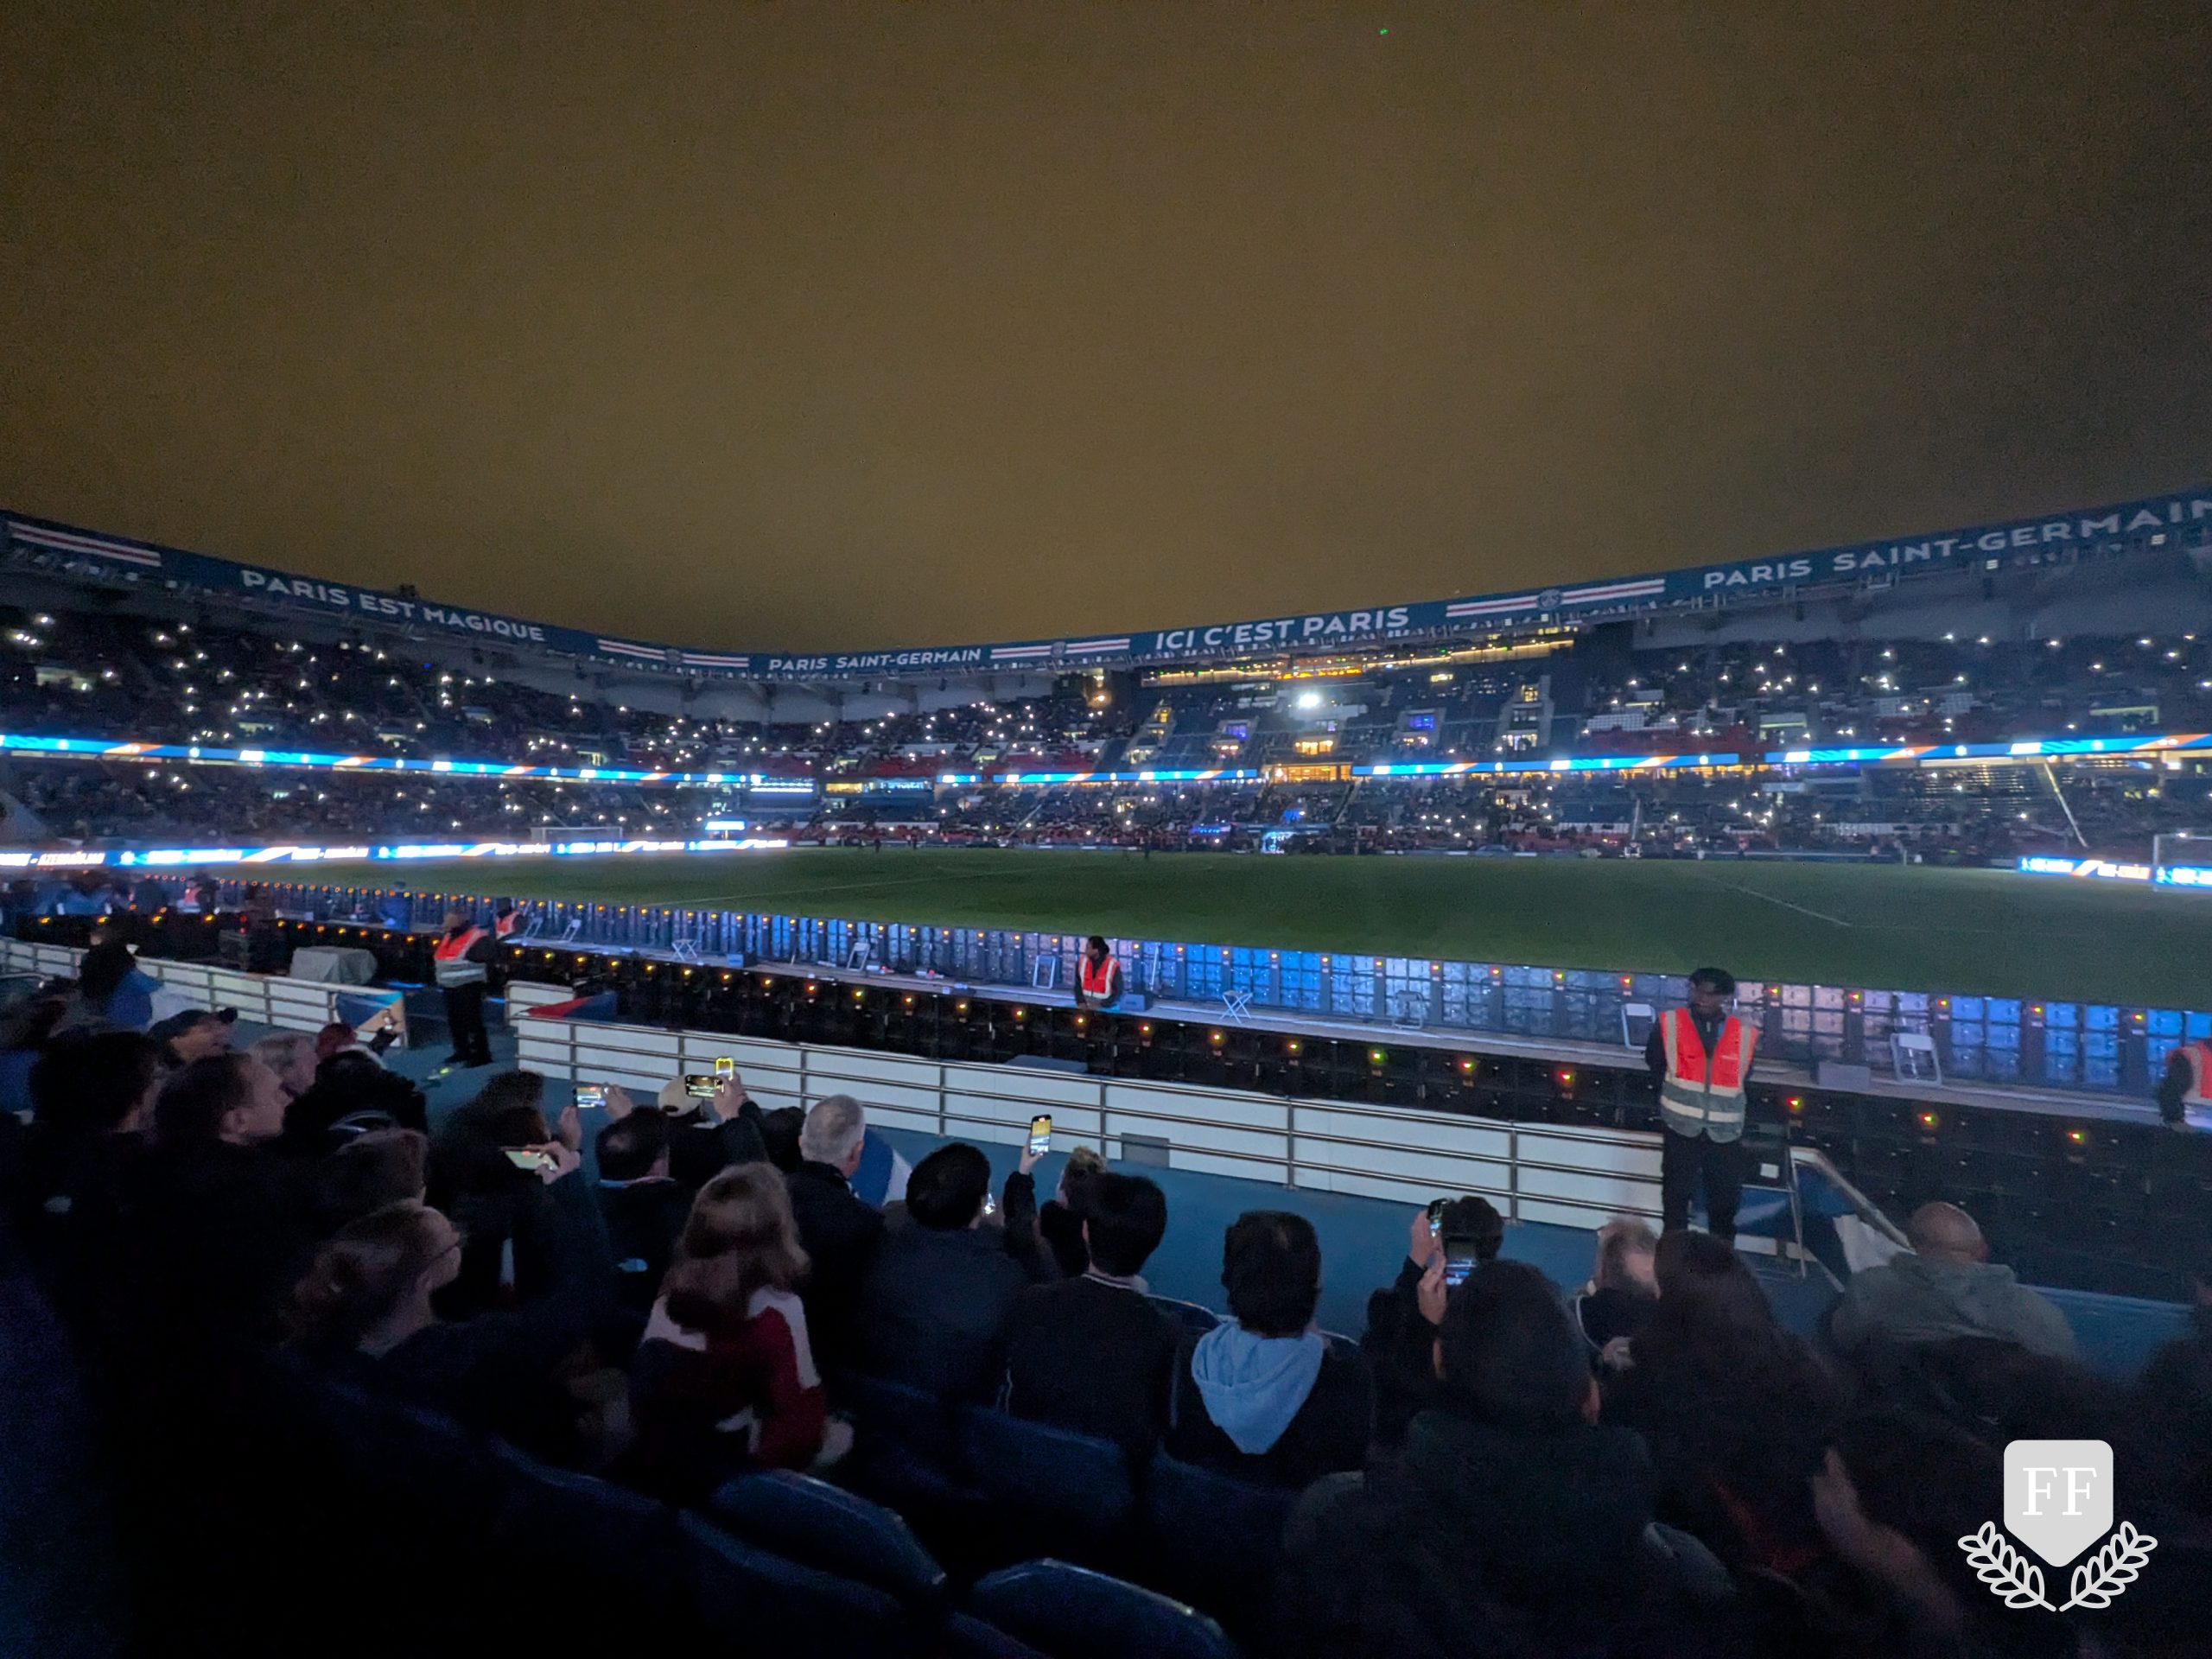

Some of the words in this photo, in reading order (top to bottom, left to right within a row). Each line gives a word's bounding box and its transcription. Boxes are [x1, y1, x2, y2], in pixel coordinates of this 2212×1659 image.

[1704, 561, 1813, 588] PARIS
[240, 569, 350, 605] PARIS
[359, 594, 415, 619] EST
[423, 607, 546, 642] MAGIQUE
[1156, 629, 1196, 650] ICI
[1204, 620, 1295, 646] C'EST
[1303, 607, 1409, 637] PARIS
[768, 658, 828, 671] PARIS
[836, 648, 982, 669] SAINT-GERMAIN
